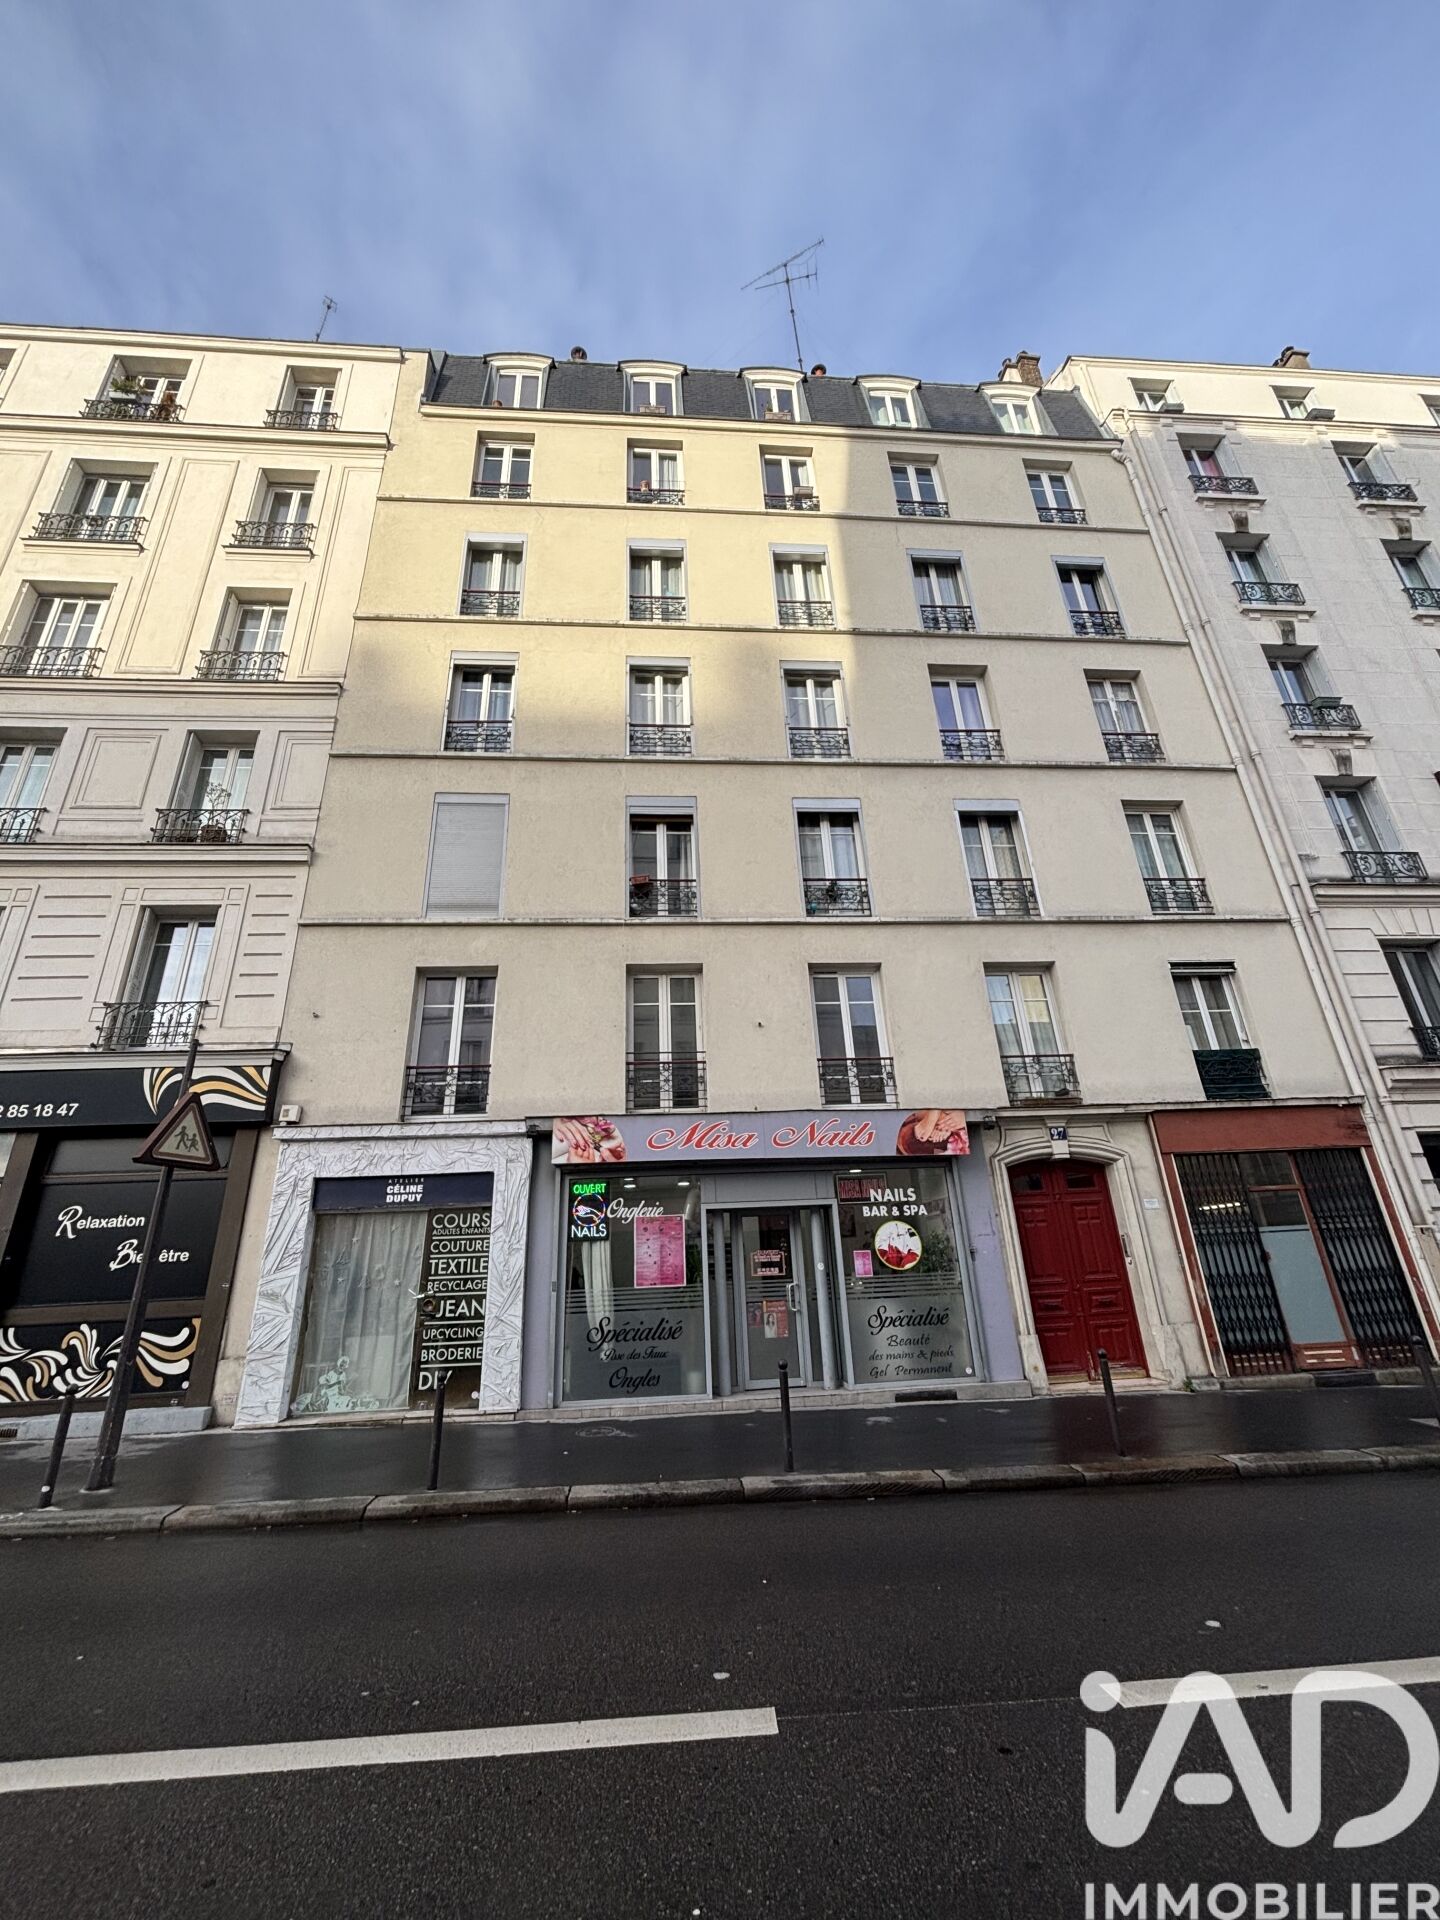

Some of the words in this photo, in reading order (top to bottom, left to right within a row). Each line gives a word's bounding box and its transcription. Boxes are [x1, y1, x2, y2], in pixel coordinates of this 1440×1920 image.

[7, 1104, 29, 1118] 85
[33, 1103, 53, 1117] 18
[56, 1103, 79, 1117] 47
[646, 1120, 759, 1151] Misa
[771, 1117, 876, 1149] Nails
[1051, 1127, 1064, 1139] 27
[386, 1184, 424, 1193] CÉLINE
[573, 1183, 606, 1194] OUVERT
[869, 1188, 917, 1202] NAILS
[386, 1194, 423, 1203] DUPUY
[607, 1197, 664, 1224] Onglerie
[862, 1205, 888, 1217] BAR
[891, 1206, 899, 1216] &
[903, 1204, 928, 1216] SPA
[55, 1205, 145, 1239] Relaxation
[432, 1212, 490, 1228] COURS
[462, 1227, 491, 1235] ENFANTS
[571, 1224, 607, 1237] NAILS
[430, 1240, 490, 1253] COUTURE
[109, 1239, 144, 1272] Bie
[158, 1249, 190, 1263] être
[429, 1258, 489, 1275] TEXTILE
[427, 1280, 487, 1292] RECYCLAGE
[435, 1299, 486, 1318] JEAN
[868, 1305, 950, 1336] Spécialisé
[422, 1327, 484, 1340] UPCYCLING
[586, 1316, 683, 1352] Spécialisé
[886, 1334, 930, 1347] Beauté
[421, 1347, 482, 1362] BRODERIE
[627, 1348, 641, 1360] des
[642, 1345, 669, 1359] Faux
[869, 1349, 884, 1361] des
[886, 1350, 914, 1360] mains
[917, 1350, 927, 1360] &
[929, 1345, 954, 1364] pieds
[870, 1363, 890, 1378] Gel
[895, 1363, 953, 1376] Permanent
[609, 1366, 661, 1394] Ongles
